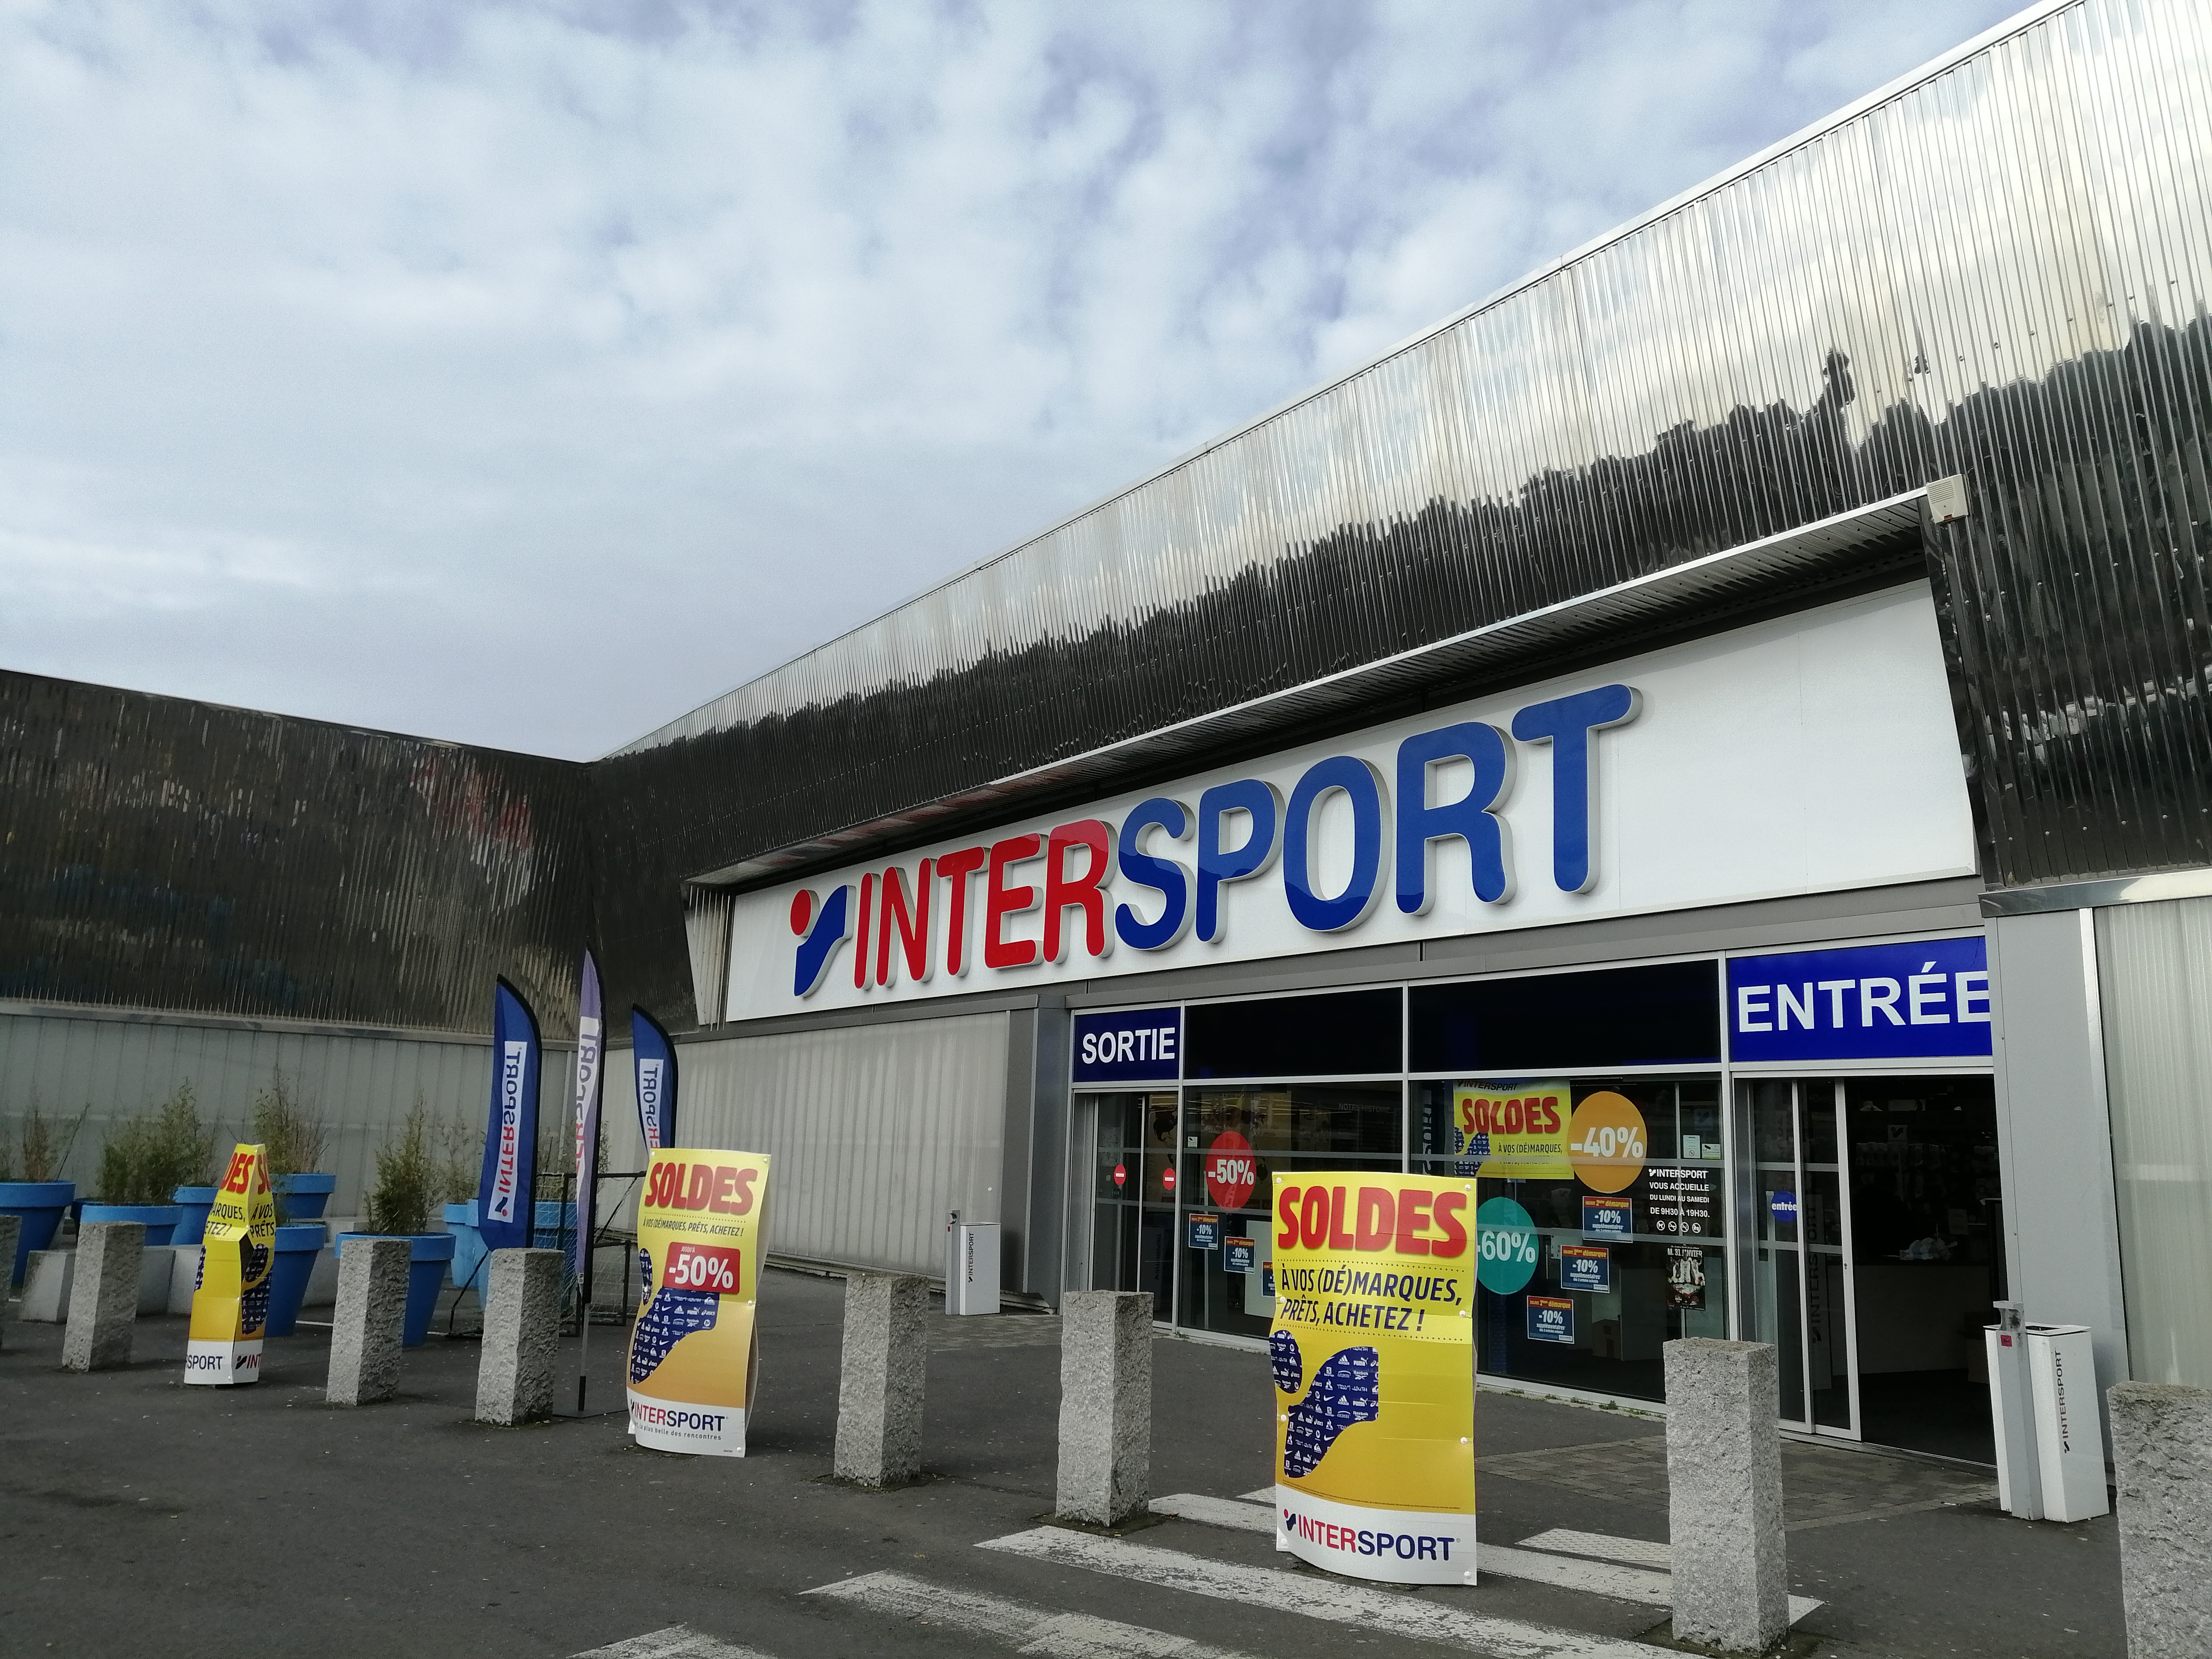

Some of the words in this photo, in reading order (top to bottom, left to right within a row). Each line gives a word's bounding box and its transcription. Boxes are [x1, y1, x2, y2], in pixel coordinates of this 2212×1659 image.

[854, 683, 1643, 990] INTERSPORT
[1738, 960, 1991, 1033] ENTRÉE
[1082, 1027, 1175, 1064] SORTIE
[1462, 1096, 1560, 1134] SOLDES
[1498, 1143, 1502, 1153] À
[1503, 1144, 1515, 1153] VOS
[1516, 1143, 1562, 1154] (DÉ)MARQUES,
[1571, 1127, 1643, 1158] -40%
[1208, 1159, 1254, 1185] -50%
[1657, 1169, 1707, 1179] INTERSPORT
[645, 1162, 758, 1215] SOLDES
[1670, 1182, 1710, 1191] ACCUEILLE
[258, 1202, 273, 1219] VOS
[1595, 1210, 1621, 1224] -10%
[1680, 1207, 1685, 1216] À
[1686, 1209, 1710, 1217] 19H30.
[1771, 1201, 1797, 1212] entrée
[653, 1218, 686, 1231] (DÉ)MARQUES,
[688, 1221, 709, 1234] PRÊTS,
[709, 1225, 740, 1236] ACHETEZ
[1196, 1224, 1212, 1235] -10%
[1278, 1186, 1467, 1258] SOLDES
[1232, 1247, 1248, 1259] -10%
[1583, 1249, 1607, 1258] démarque
[1807, 1205, 1821, 1323] INTERSORT
[669, 1254, 734, 1289] -50%
[1573, 1259, 1599, 1273] -10%
[1281, 1263, 1290, 1290] À
[1290, 1268, 1315, 1292] VOS
[1318, 1264, 1462, 1306] (DÉ)MARQUES,
[1280, 1294, 1320, 1326] PRÊTS,
[1323, 1302, 1413, 1331] ACHETEZ
[1417, 1309, 1425, 1332] !
[1548, 1300, 1571, 1309] démarque
[1538, 1310, 1563, 1324] -10%
[2055, 1350, 2069, 1439] INTERSPORT
[634, 1402, 725, 1432] INTERSPORT
[684, 1432, 721, 1440] rencontres
[1298, 1513, 1455, 1561] INTERSPORT
